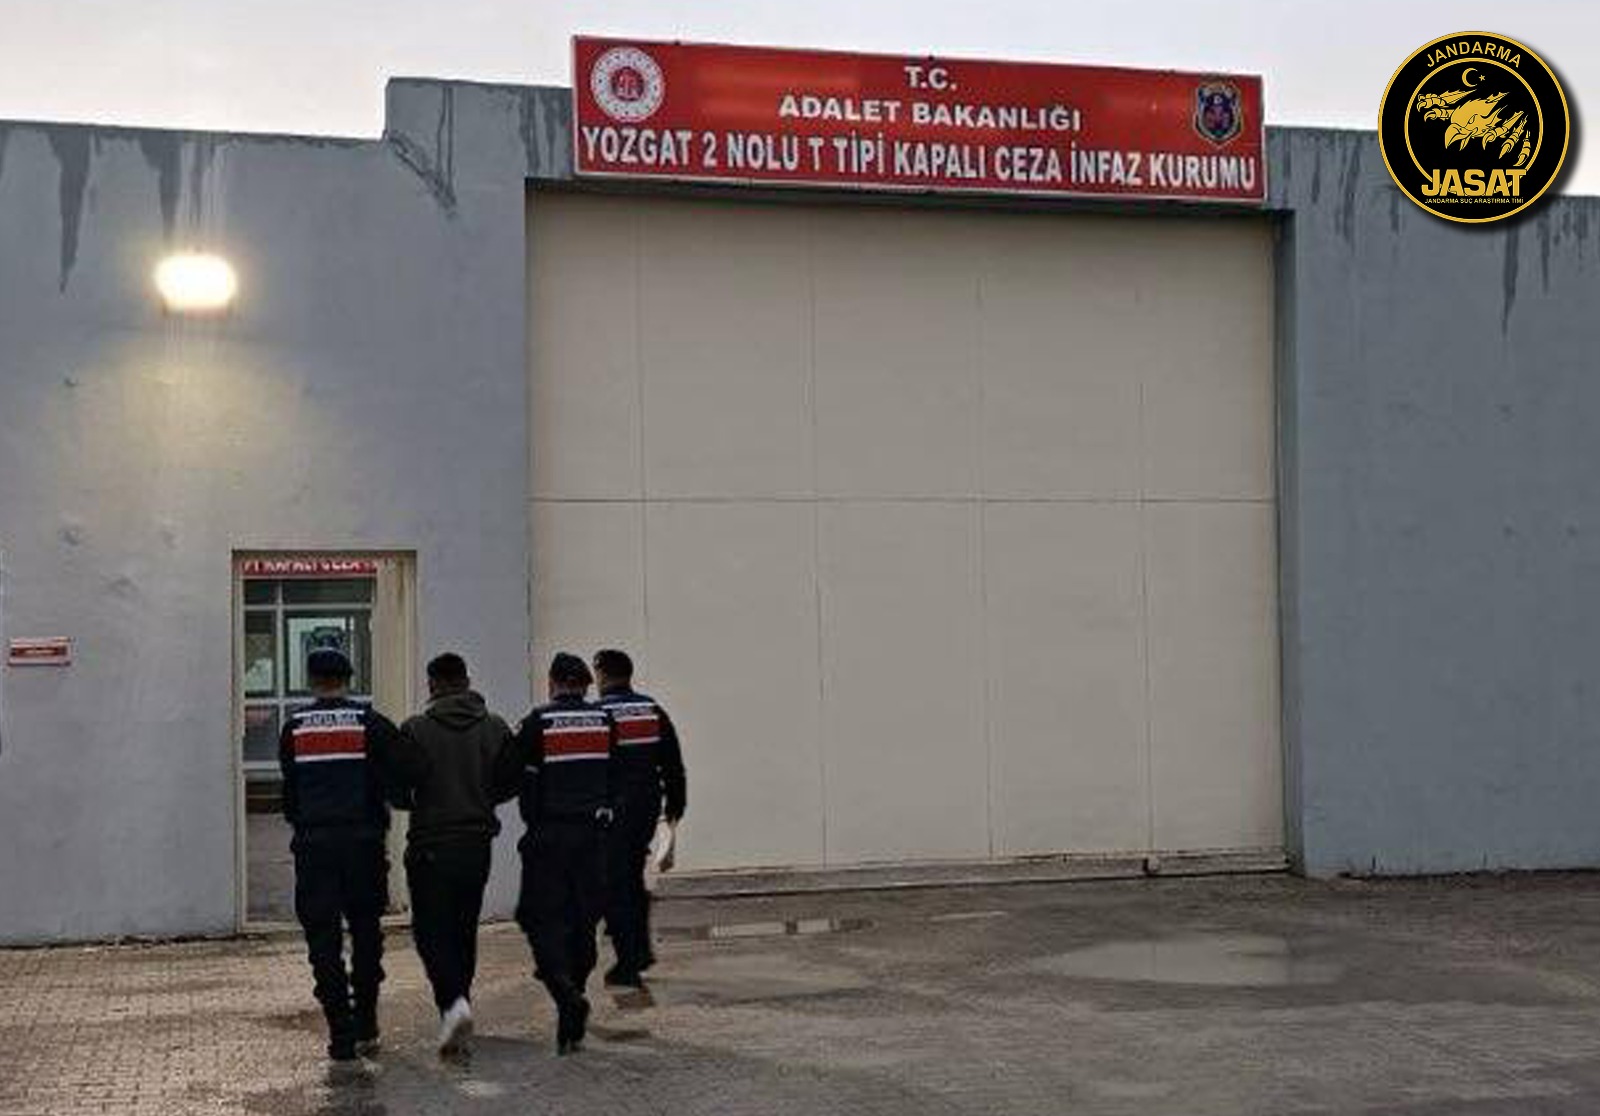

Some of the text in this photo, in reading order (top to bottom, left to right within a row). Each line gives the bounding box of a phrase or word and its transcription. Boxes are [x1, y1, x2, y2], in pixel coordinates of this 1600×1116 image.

[905, 66, 957, 90] T.C.
[778, 95, 1081, 132] ADALET BAKANLIĞI
[582, 126, 1256, 190] YOZGAT 2 NOLU T TİPİ KAPALI CEZA İNFAZ KURUMU
